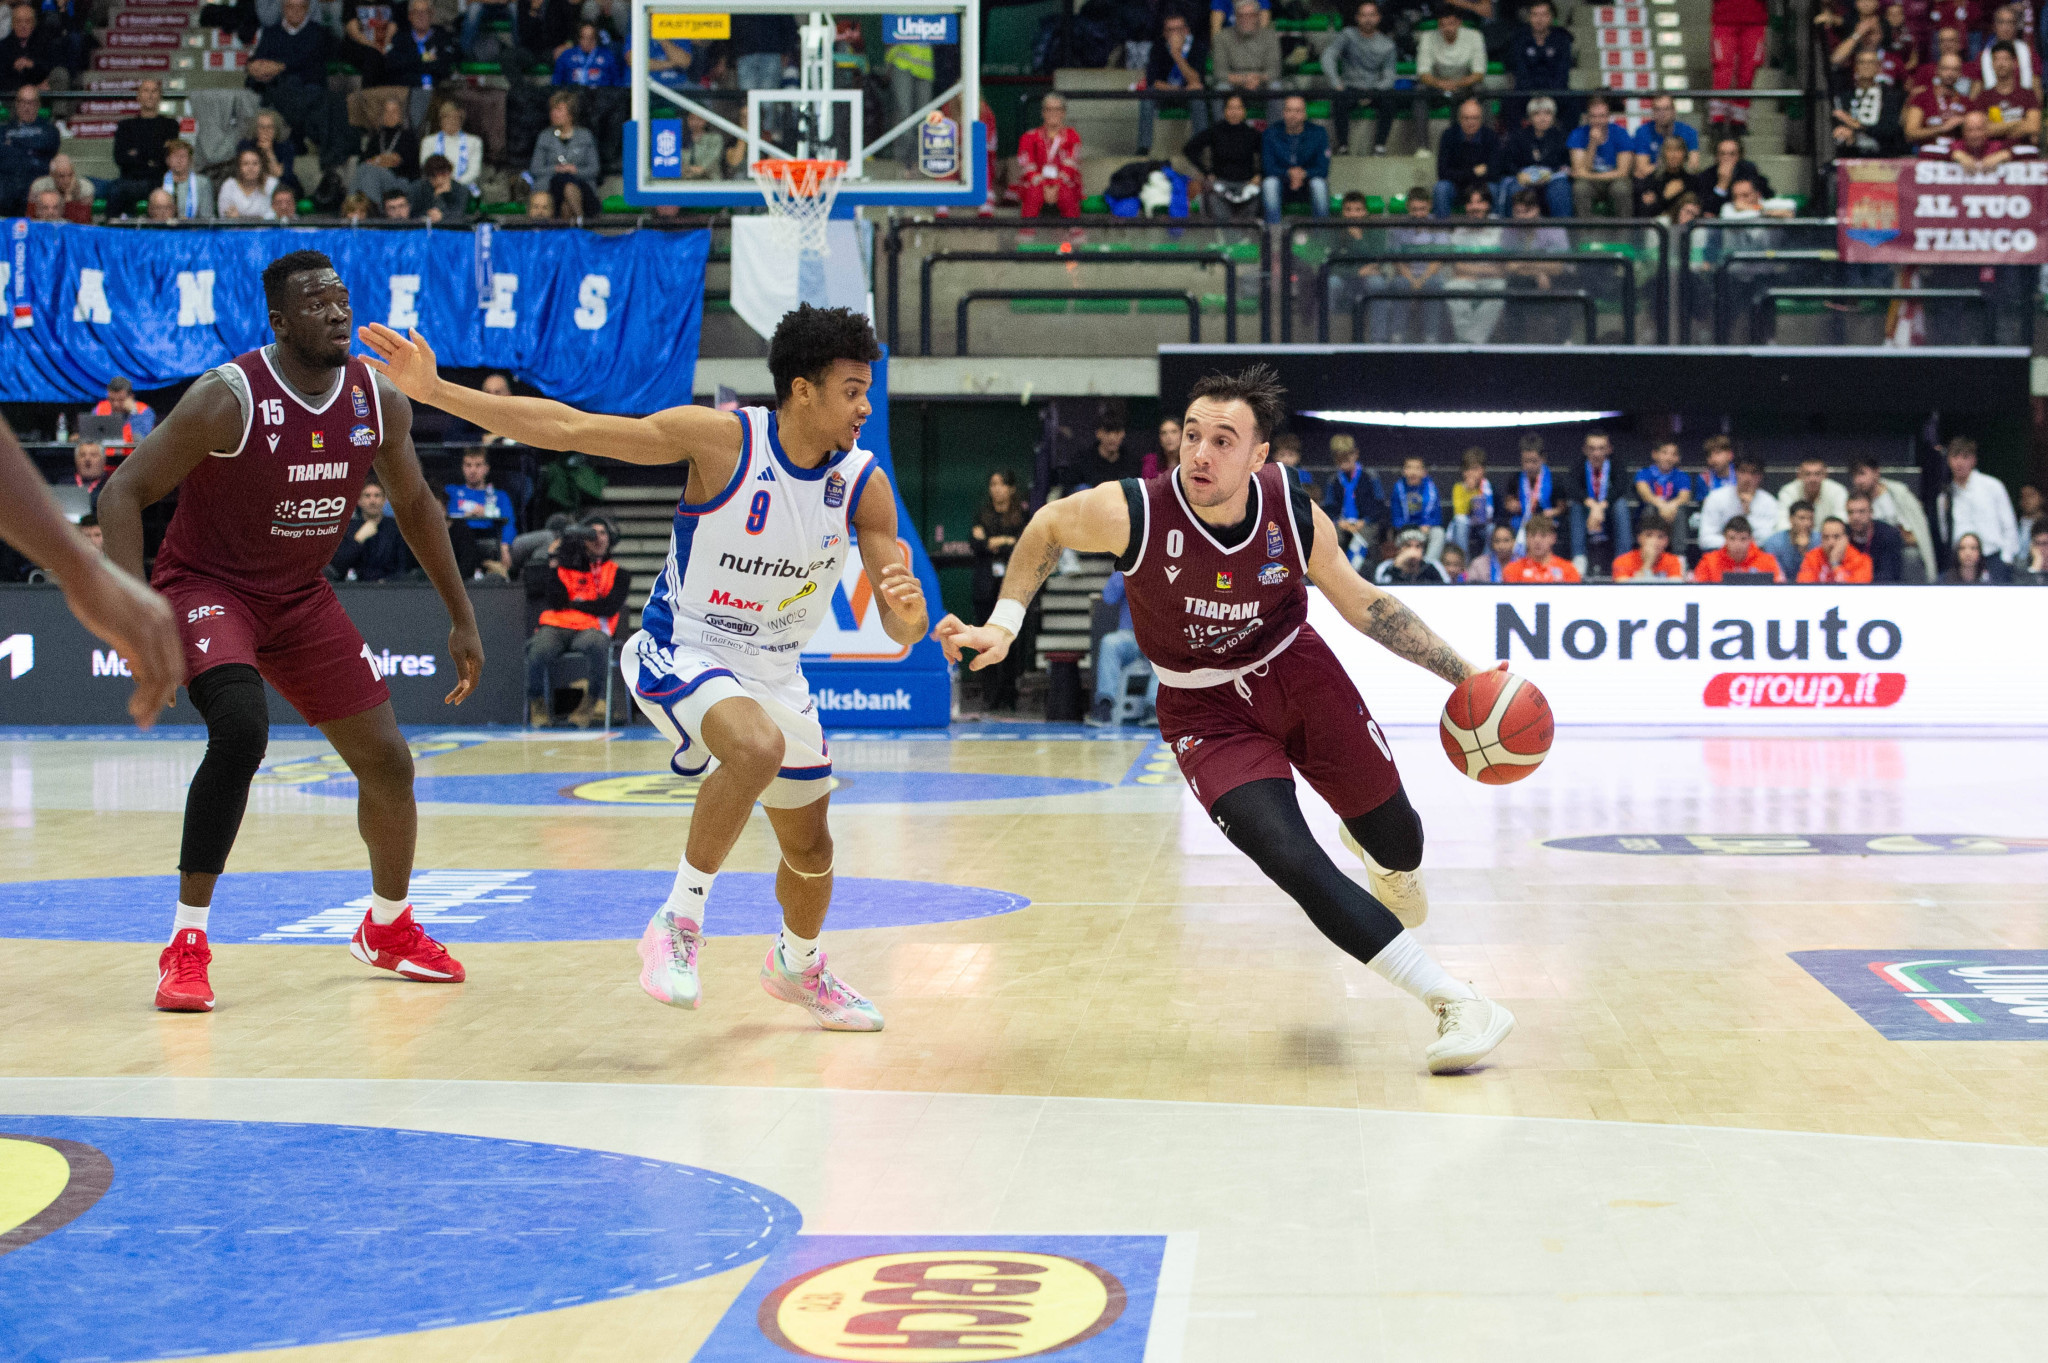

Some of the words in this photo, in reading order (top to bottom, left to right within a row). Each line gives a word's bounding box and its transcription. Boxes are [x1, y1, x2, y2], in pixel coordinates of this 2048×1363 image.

[896, 17, 947, 40] Unipol
[1914, 195, 1958, 218] AL
[1962, 195, 2032, 219] TUO
[1914, 228, 2037, 252] FIANCO
[258, 399, 285, 426] 15
[287, 462, 349, 482] TRAPANI
[745, 490, 771, 535] 9
[270, 526, 304, 538] Energy
[305, 528, 315, 536] to
[316, 525, 339, 536] build
[1166, 529, 1184, 558] 0
[1257, 572, 1289, 582] TRAPANI
[1184, 596, 1260, 620] TRAPANI
[1226, 637, 1239, 648] to
[1496, 602, 1902, 661] Nordauto
[777, 641, 799, 652] group
[1728, 673, 1881, 707] group.it
[835, 1259, 1049, 1351] CRICH
